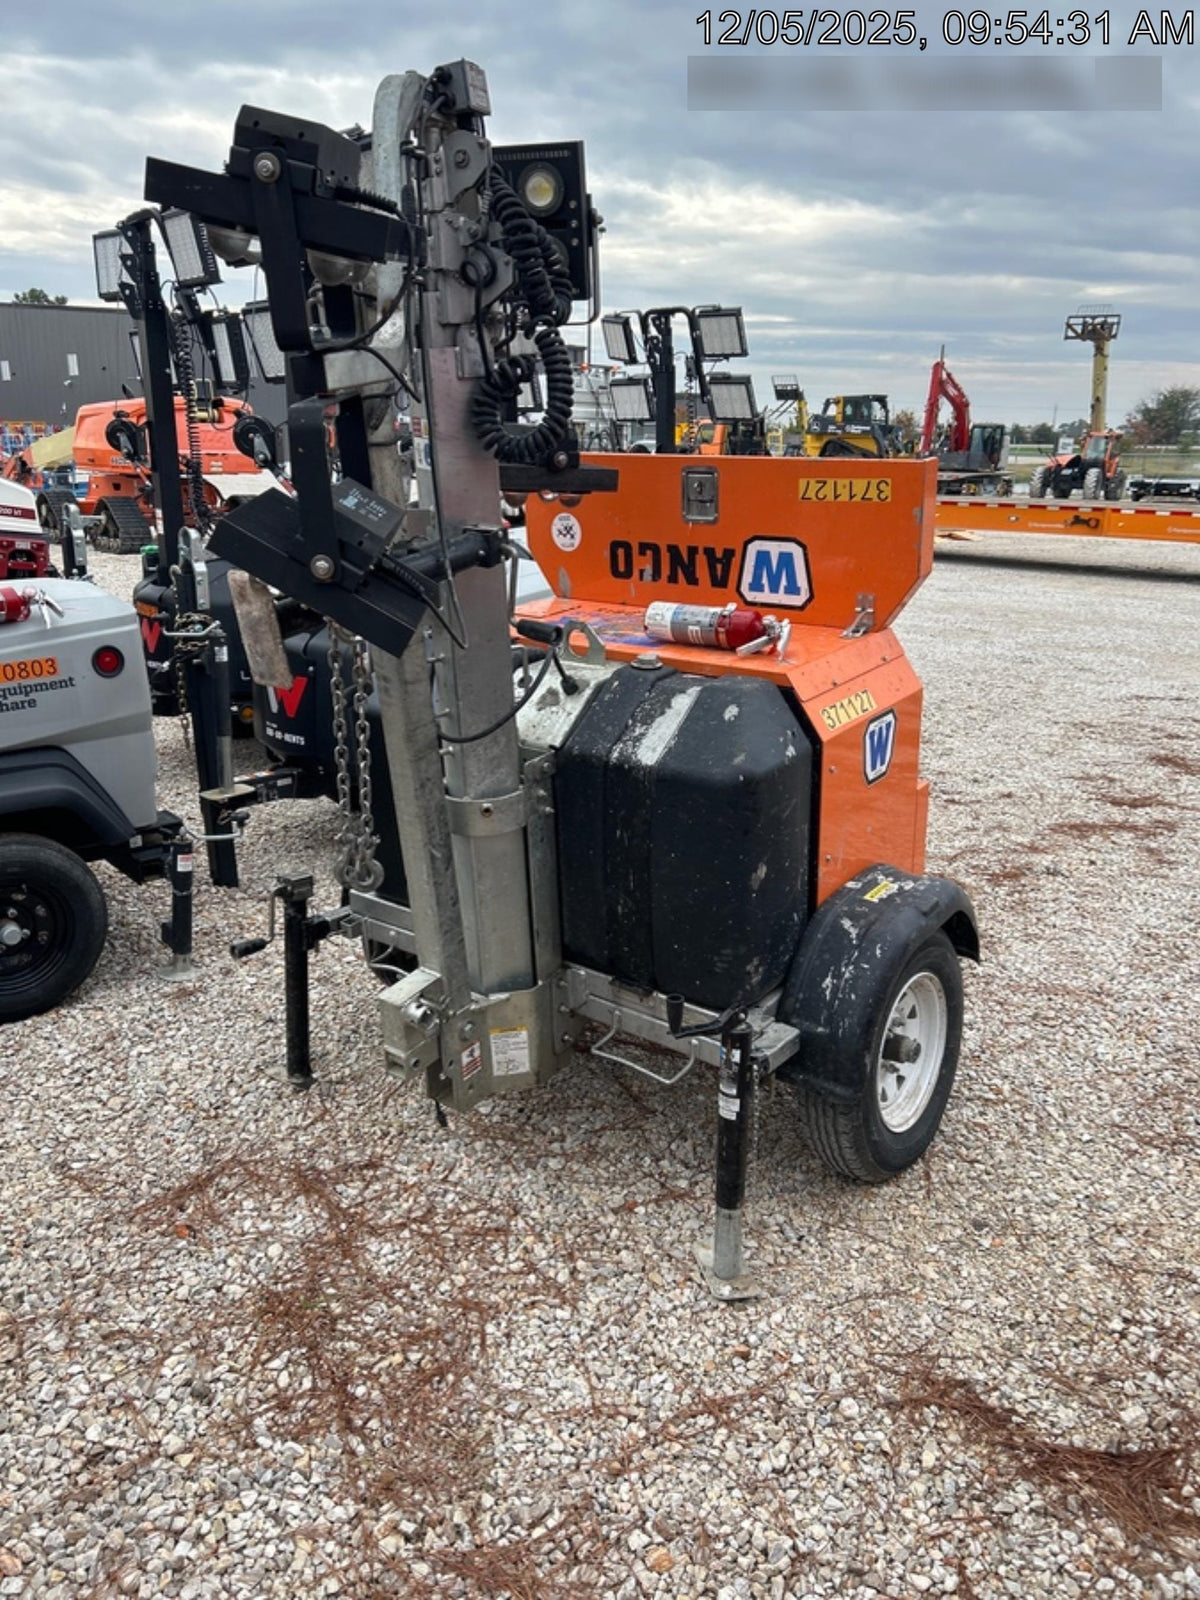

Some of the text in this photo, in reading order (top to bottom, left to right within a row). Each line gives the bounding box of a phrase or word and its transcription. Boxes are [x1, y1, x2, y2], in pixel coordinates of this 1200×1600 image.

[801, 479, 890, 502] 371127
[820, 689, 874, 729] 371127
[868, 720, 893, 772] W
